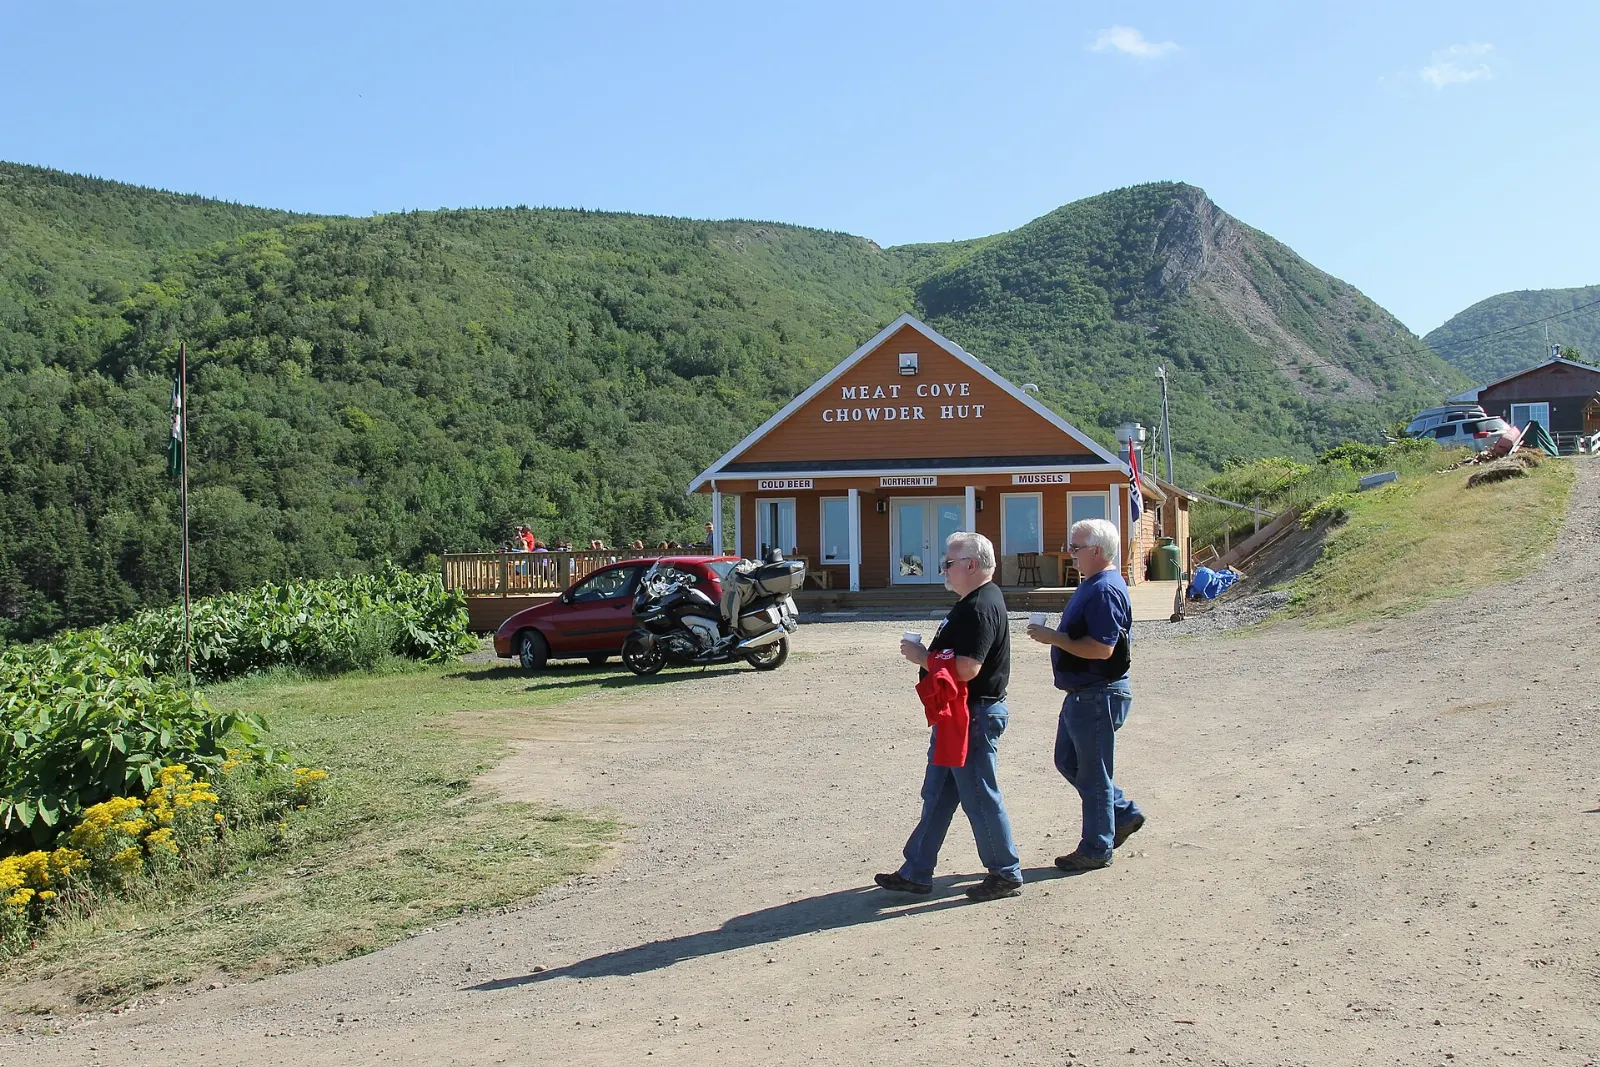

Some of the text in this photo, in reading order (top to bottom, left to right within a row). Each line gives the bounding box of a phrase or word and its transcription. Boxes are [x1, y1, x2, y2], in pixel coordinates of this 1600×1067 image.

[841, 383, 970, 400] MEAT COVE
[822, 404, 985, 422] CHOWDER HUT
[882, 477, 935, 486] NORTHERN TIP
[1018, 474, 1064, 483] MUSSELS
[761, 480, 810, 489] COLD BEER
